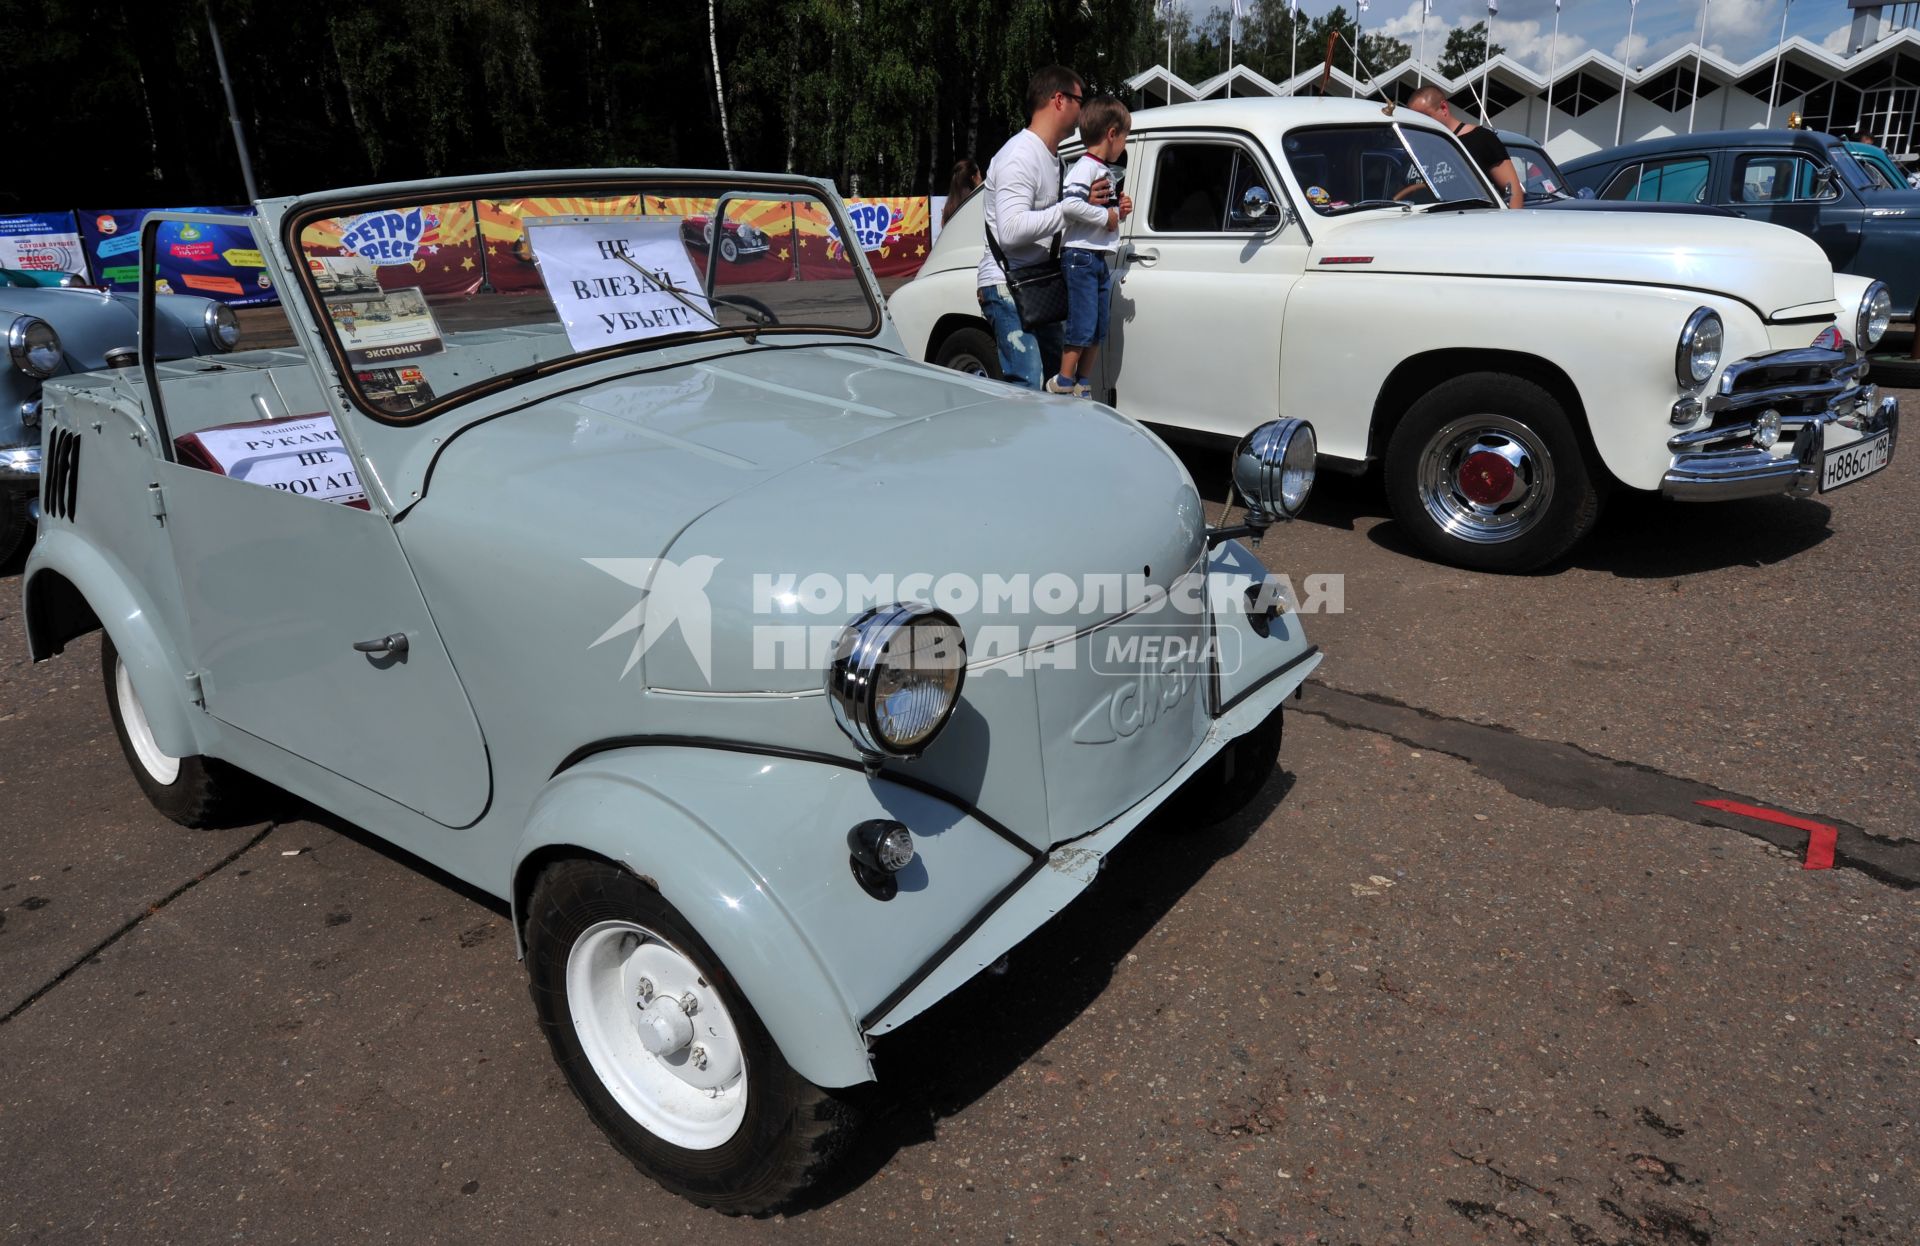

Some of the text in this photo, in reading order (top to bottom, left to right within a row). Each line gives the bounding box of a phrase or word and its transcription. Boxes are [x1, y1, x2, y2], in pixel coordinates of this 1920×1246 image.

[342, 207, 422, 249] РЕТРО
[856, 230, 883, 245] ЕСТ
[360, 240, 415, 260] ФЕСТ
[596, 239, 635, 260] НЕ
[598, 307, 691, 335] УБЪЕТ!
[365, 343, 422, 359] ЭКСПОНАТ
[262, 423, 317, 435] МАШИНКУ
[296, 450, 334, 467] НЕ
[1828, 436, 1887, 485] Н886СТ 199
[265, 471, 361, 495] РОГАТ
